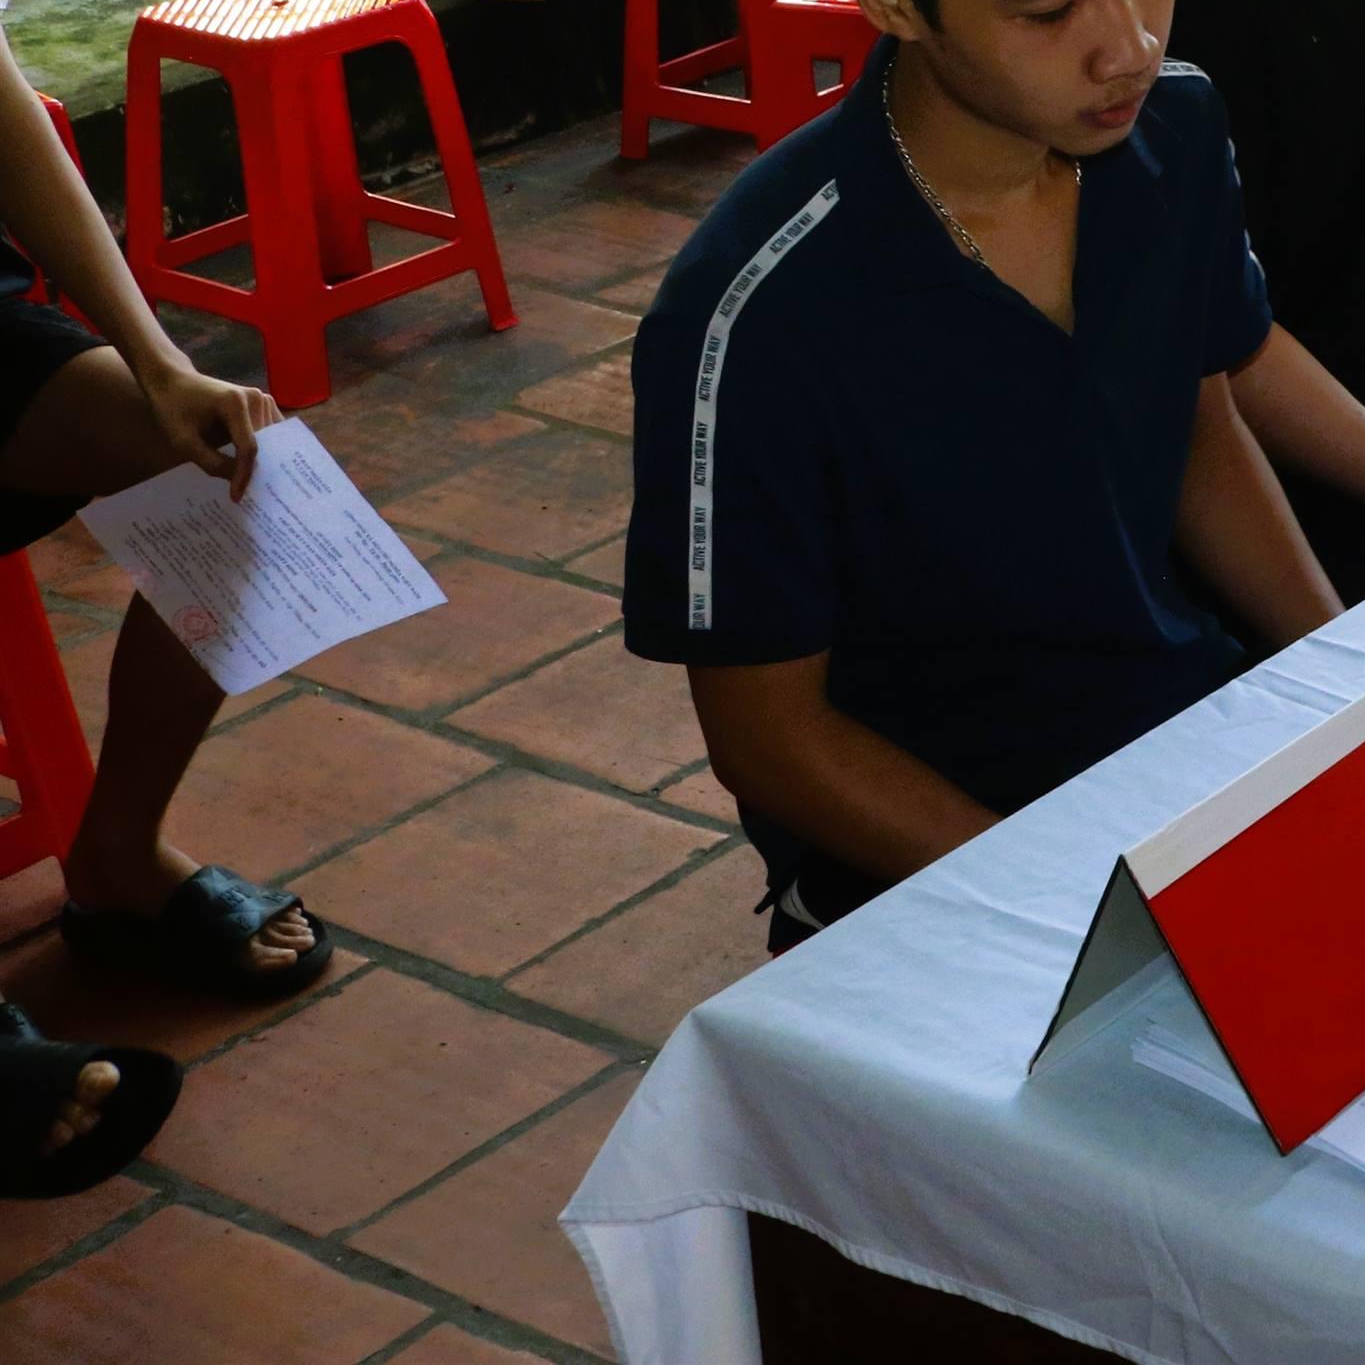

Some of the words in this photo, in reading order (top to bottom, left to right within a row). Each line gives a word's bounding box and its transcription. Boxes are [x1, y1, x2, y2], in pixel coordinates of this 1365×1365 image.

[769, 234, 792, 255] ACTIVE
[798, 212, 815, 227] WAY
[719, 292, 742, 318] ACTIVE
[733, 274, 753, 294] YOUR
[745, 263, 763, 278] WAY
[707, 335, 721, 353] WAY
[702, 353, 717, 375] YOUR
[698, 375, 713, 402] ACTIVE
[695, 421, 709, 439] WAY
[694, 439, 707, 459] YOUR
[694, 459, 707, 487] ACTIVE
[694, 506, 706, 524] WAY
[694, 525, 706, 545] YOUR
[692, 545, 706, 571] ACTIVE
[693, 594, 706, 612] WAY
[692, 612, 705, 629] OUR
